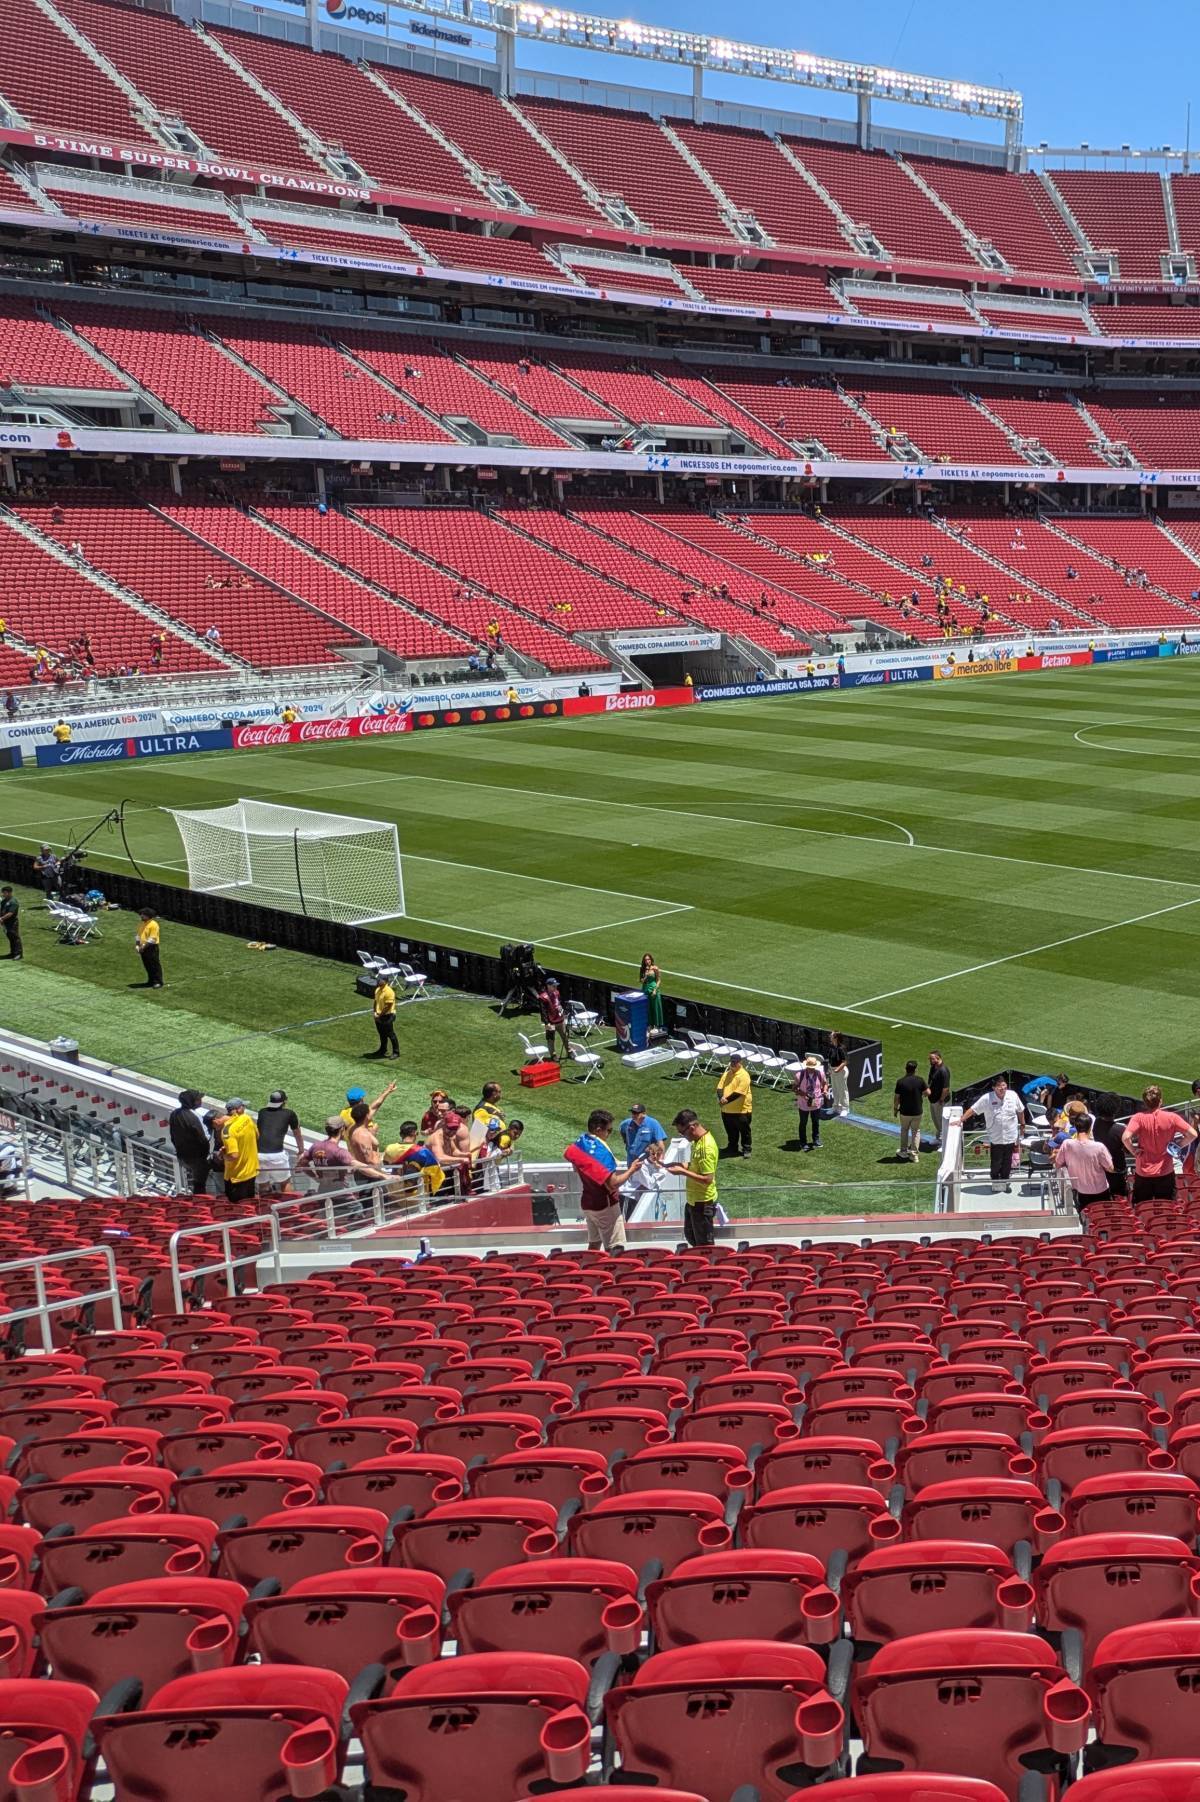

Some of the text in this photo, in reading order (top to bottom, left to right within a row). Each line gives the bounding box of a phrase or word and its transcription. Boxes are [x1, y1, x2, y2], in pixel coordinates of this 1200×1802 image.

[348, 7, 386, 25] pepsi
[412, 22, 472, 46] ticketmaster
[34, 136, 371, 200] 5-TIME SUPER BOWL CHAMPIONS
[118, 228, 230, 250] TICKETS AT copaamerica.com
[312, 254, 338, 265] TICKETS
[350, 260, 407, 272] copaamerica.com
[510, 281, 538, 290] INGRESSOS
[680, 460, 798, 474] INGRESSOS EM copaamerica.com
[941, 469, 1046, 481] TICKETS AT copaamerica.com
[615, 644, 647, 652] CONMEBOL
[664, 640, 689, 649] AMERICA
[689, 639, 700, 647] USA
[957, 661, 1012, 674] mercado libre
[1042, 655, 1072, 668] Betano
[891, 670, 919, 681] ULTRA
[414, 693, 450, 703] ONMEBOL
[451, 692, 470, 701] COPA
[471, 690, 502, 700] AMERICA
[518, 688, 534, 696] 2024
[703, 677, 830, 699] CONMEBOL COPA AMERICA USA 2024
[606, 693, 656, 711] Betano
[170, 704, 324, 724] CONMEBOL COPA AMERICA 2024
[8, 713, 157, 738] CONMEBO AMERICA USA 2024
[301, 719, 352, 741] Coca-Cola
[359, 714, 408, 735] Coca-Cola
[238, 724, 291, 747] Coca-Cola
[60, 736, 201, 763] Michelob ULTRA
